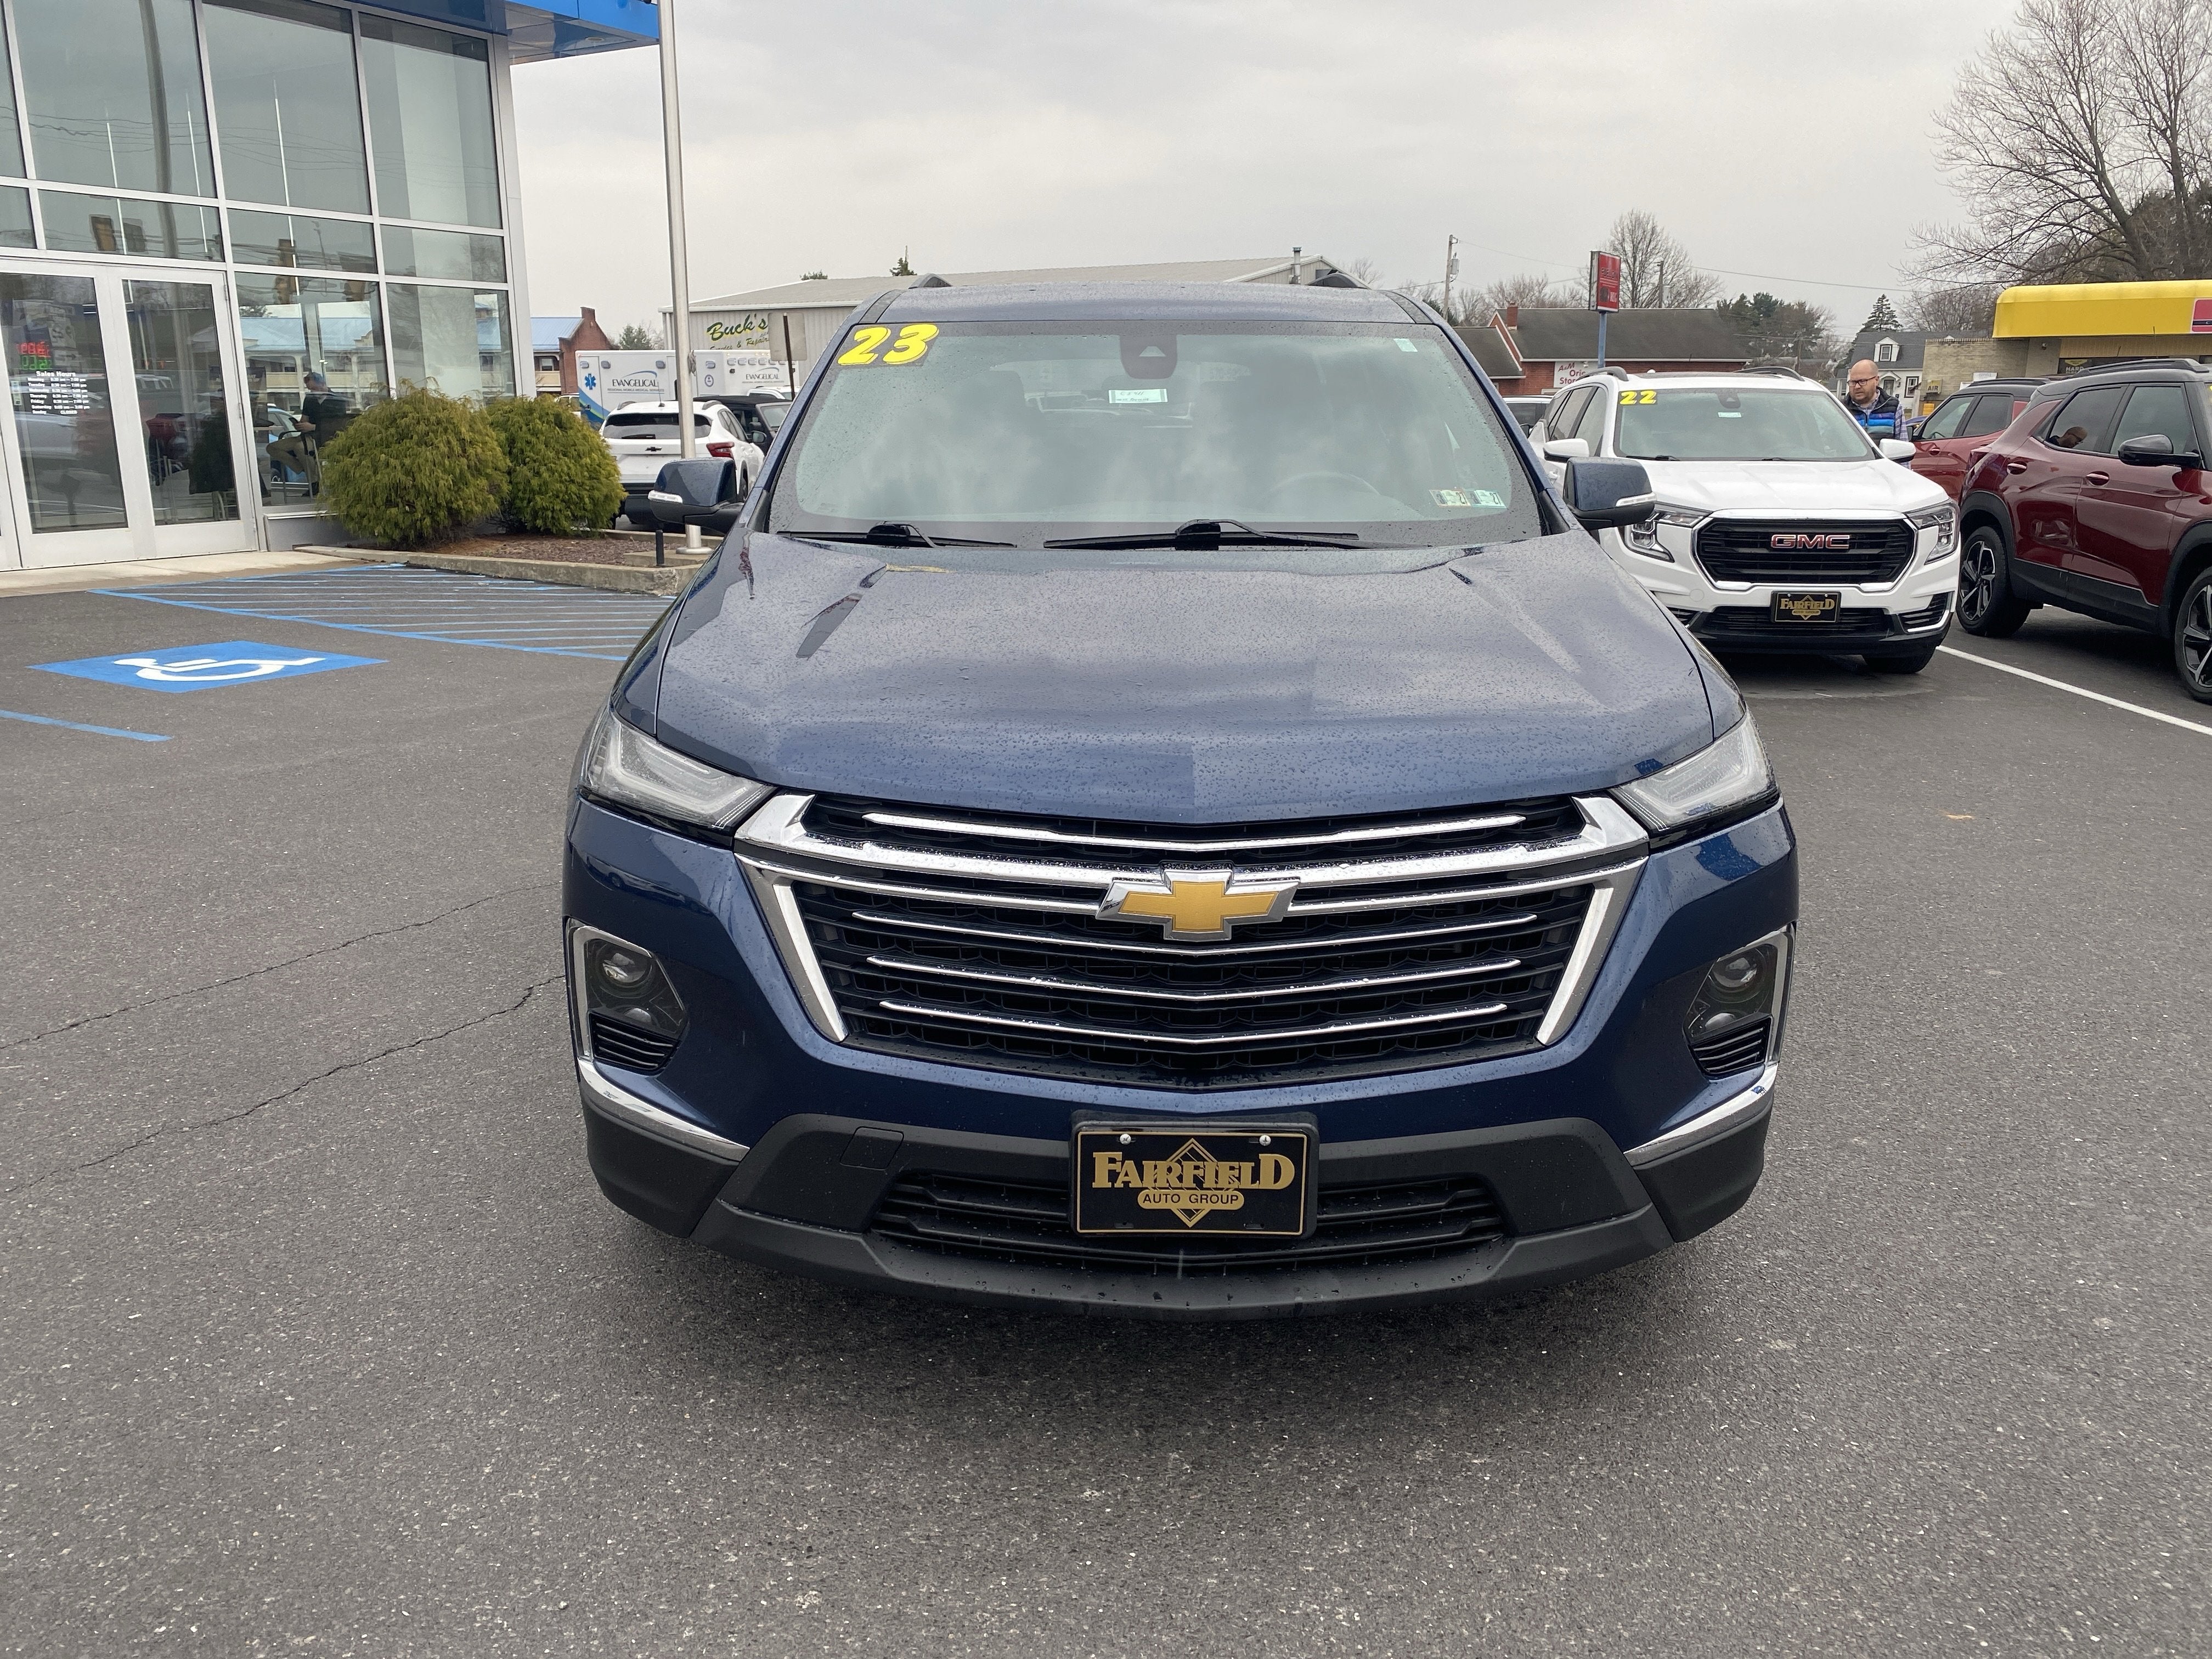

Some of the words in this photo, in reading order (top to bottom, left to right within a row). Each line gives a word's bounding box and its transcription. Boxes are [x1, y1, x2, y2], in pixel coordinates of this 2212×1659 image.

[707, 313, 769, 341] Buck's
[837, 323, 940, 366] 23
[1620, 390, 1657, 405] 22
[1771, 534, 1850, 549] GMC
[1780, 599, 1835, 610] FAIRFIELD
[1092, 1152, 1295, 1190] FAIRFIELD
[1142, 1193, 1181, 1204] AUTO
[1188, 1194, 1239, 1205] GROUP
